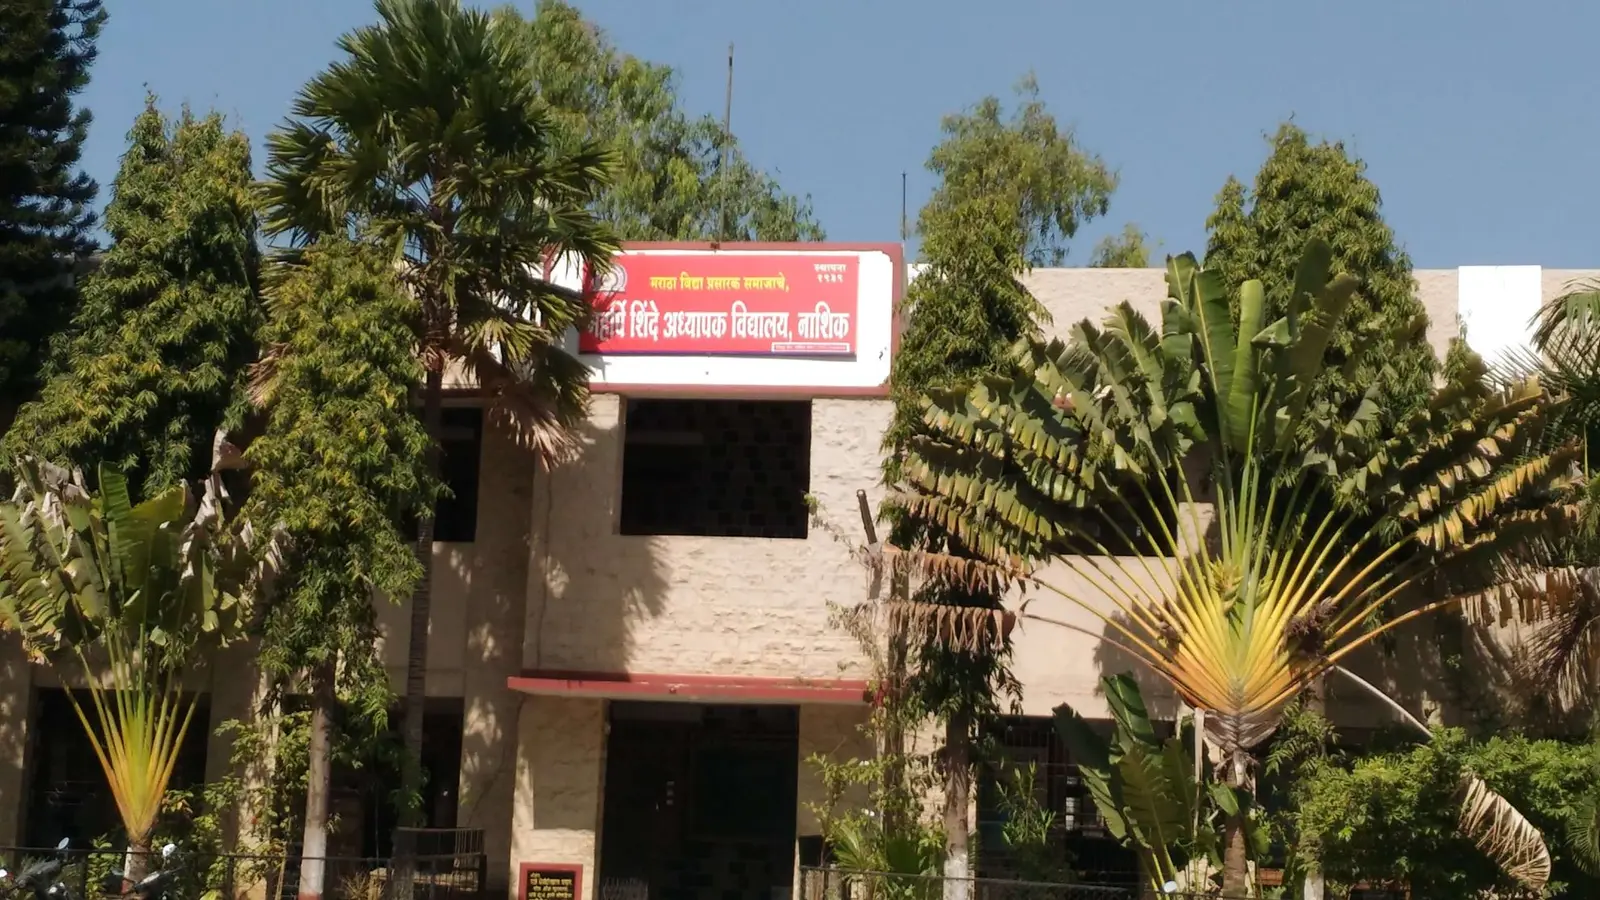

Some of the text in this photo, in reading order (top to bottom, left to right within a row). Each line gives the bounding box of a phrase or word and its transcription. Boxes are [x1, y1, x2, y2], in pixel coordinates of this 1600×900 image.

[649, 276, 677, 290] मराठा
[680, 271, 704, 290] विद्या
[706, 276, 741, 290] प्रसारक
[630, 299, 660, 341] शिंदे
[662, 310, 728, 339] अध्यापक
[731, 300, 793, 343] विद्यालय,
[797, 301, 850, 339] नाशिक
